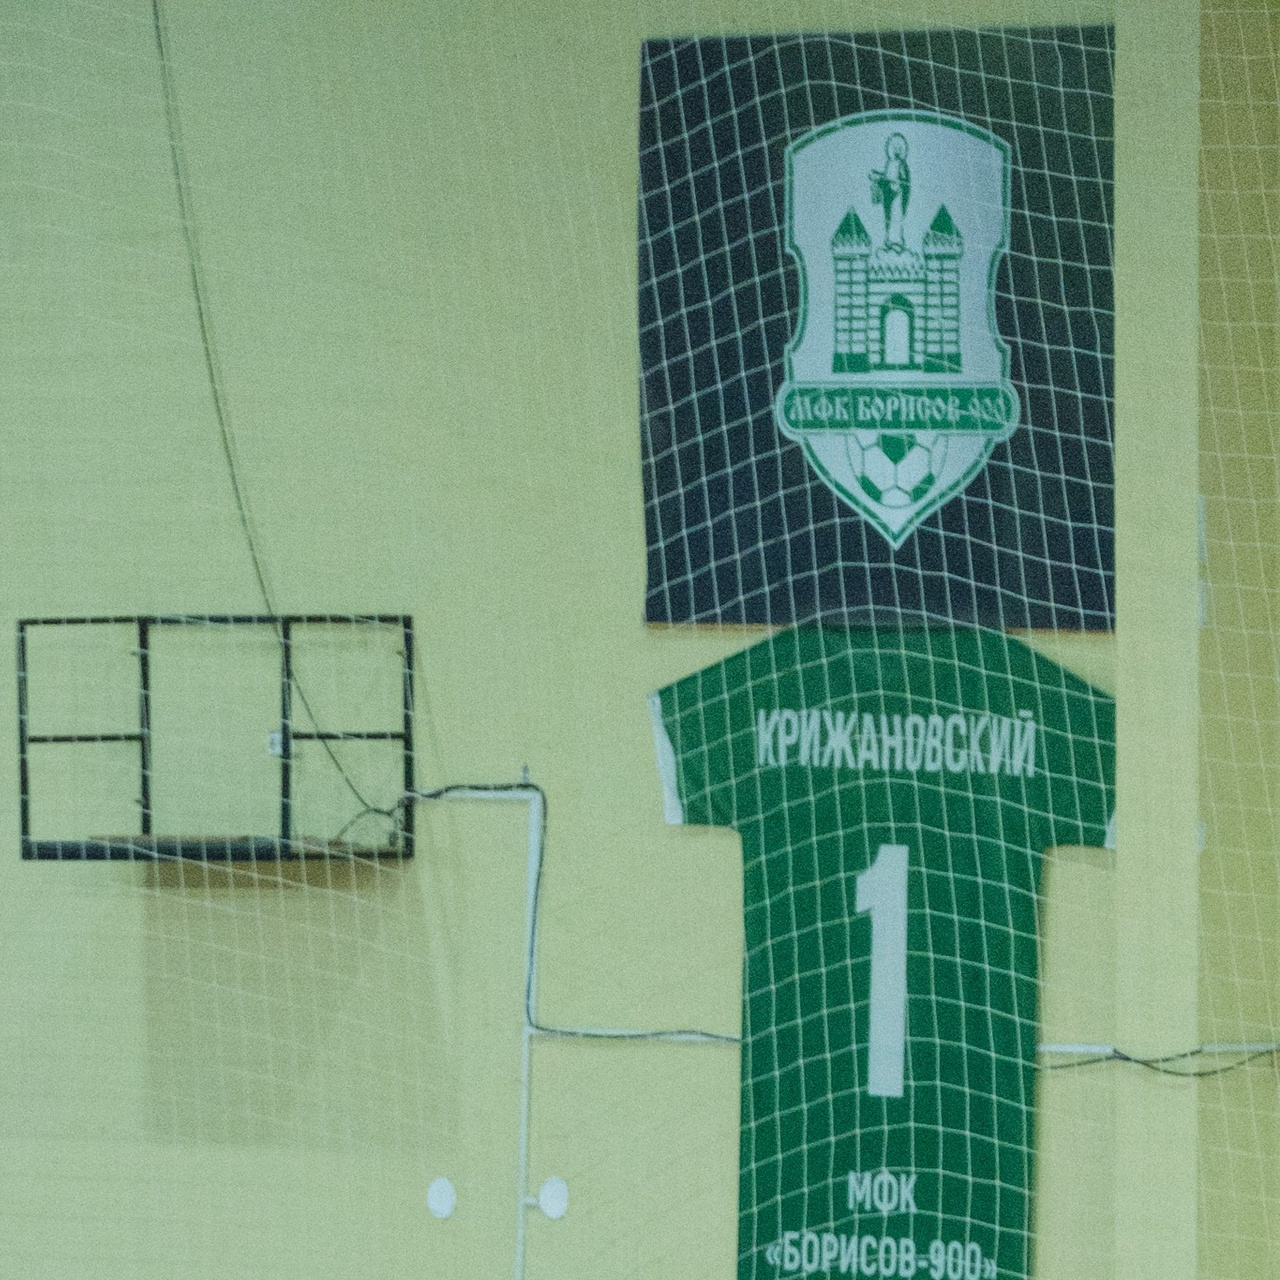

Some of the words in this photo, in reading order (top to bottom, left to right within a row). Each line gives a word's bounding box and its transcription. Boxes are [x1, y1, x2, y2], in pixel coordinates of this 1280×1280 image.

[757, 707, 1037, 778] КРИЖАНОВСКИЙ
[855, 843, 910, 1098] 1
[847, 1169, 917, 1216] МФК
